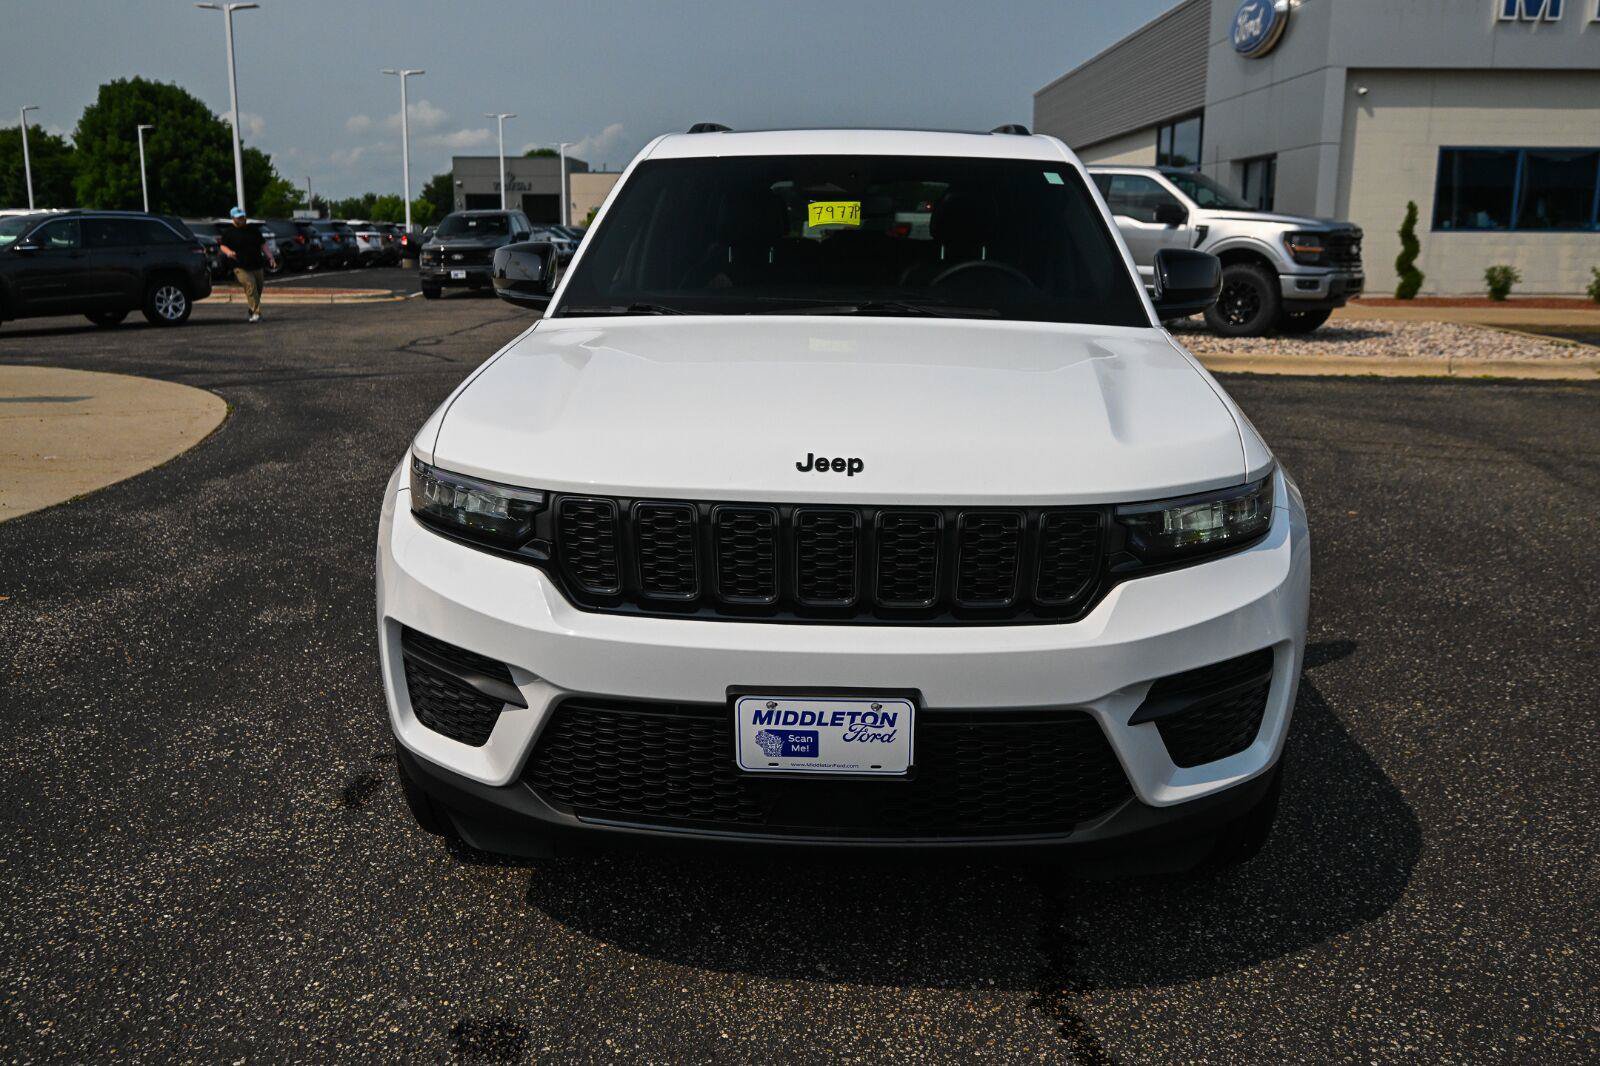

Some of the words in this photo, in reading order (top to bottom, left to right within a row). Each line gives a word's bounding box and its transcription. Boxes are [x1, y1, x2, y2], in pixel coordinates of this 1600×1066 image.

[1234, 2, 1265, 44] Ford
[796, 453, 864, 476] Jeep
[752, 709, 898, 728] MIDDLETON
[787, 734, 813, 743] Scan
[842, 723, 897, 744] Ford
[791, 744, 810, 752] Me!
